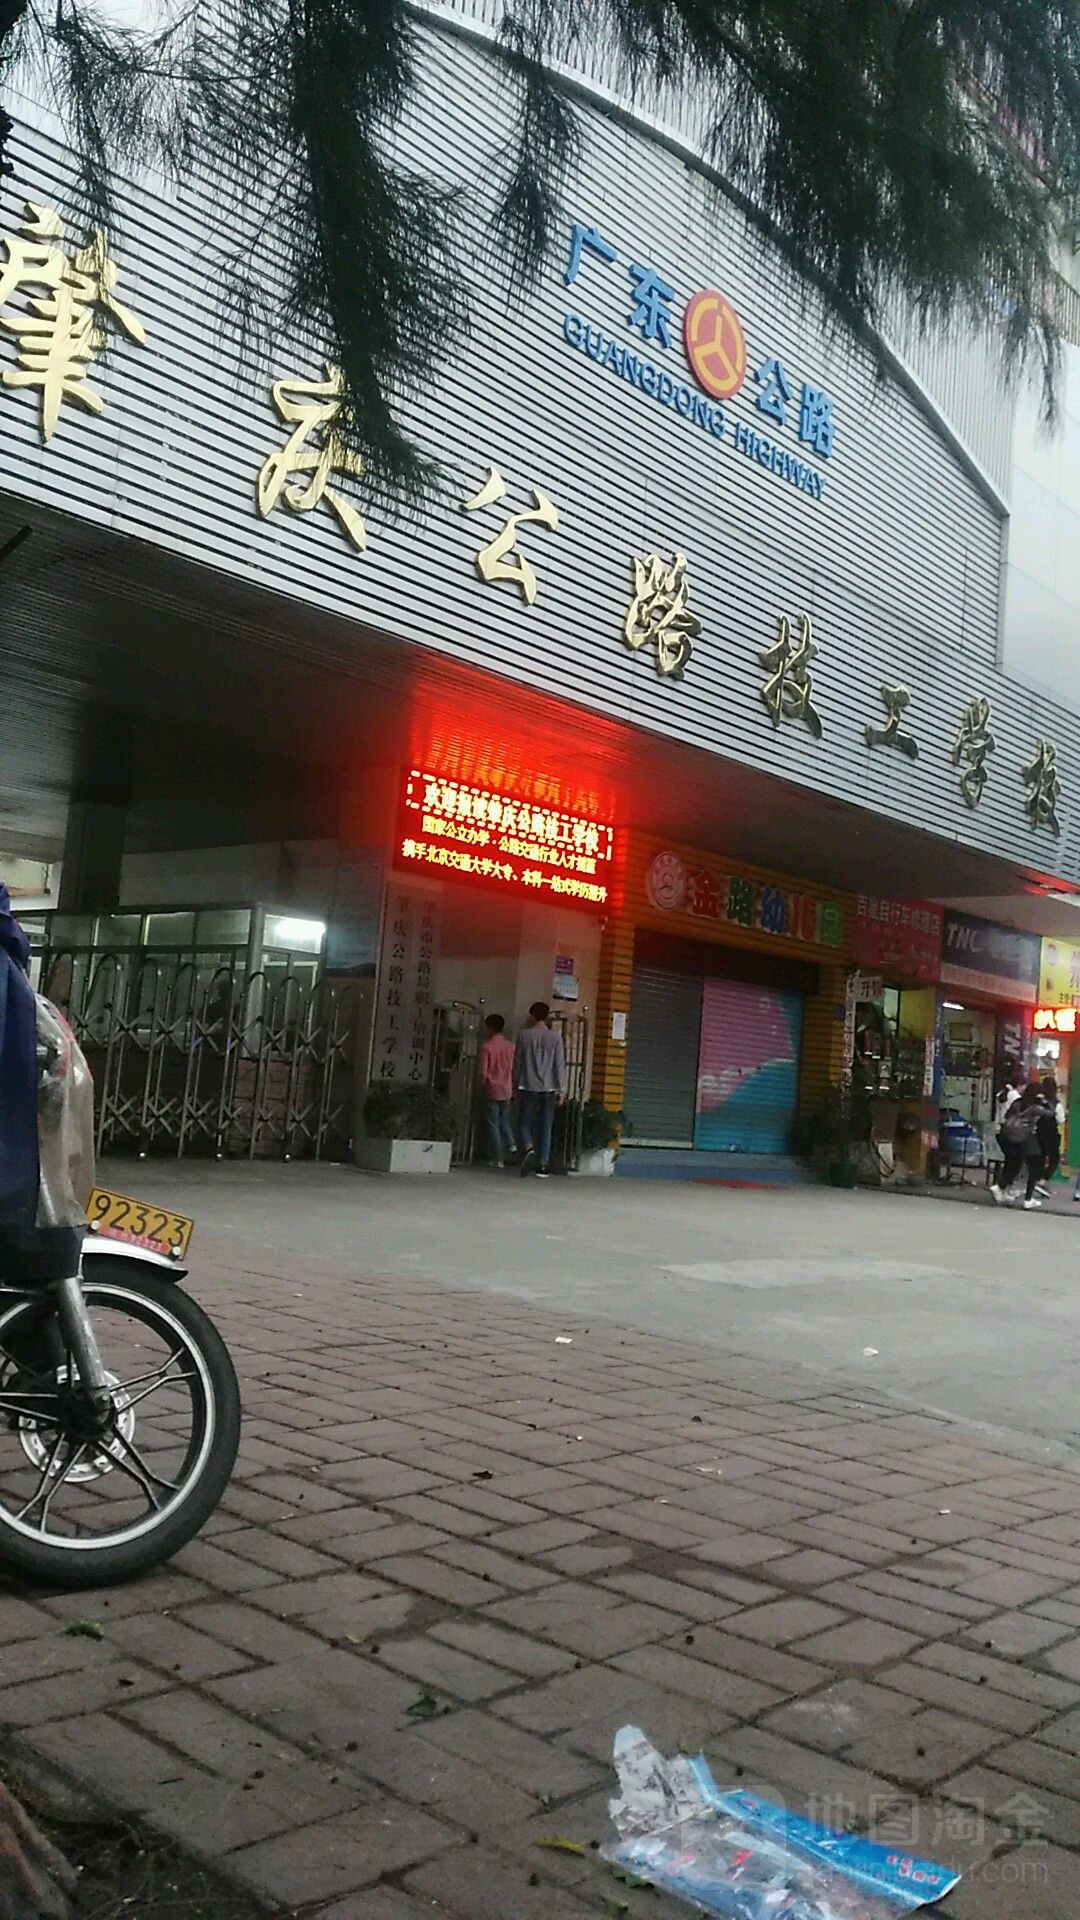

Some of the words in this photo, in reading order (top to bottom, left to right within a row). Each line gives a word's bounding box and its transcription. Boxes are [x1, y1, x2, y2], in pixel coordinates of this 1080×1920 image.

[563, 314, 727, 438] GUANGDONG
[734, 421, 827, 500] HIGHWAY
[946, 923, 984, 953] TNC
[93, 1194, 187, 1248] 92323
